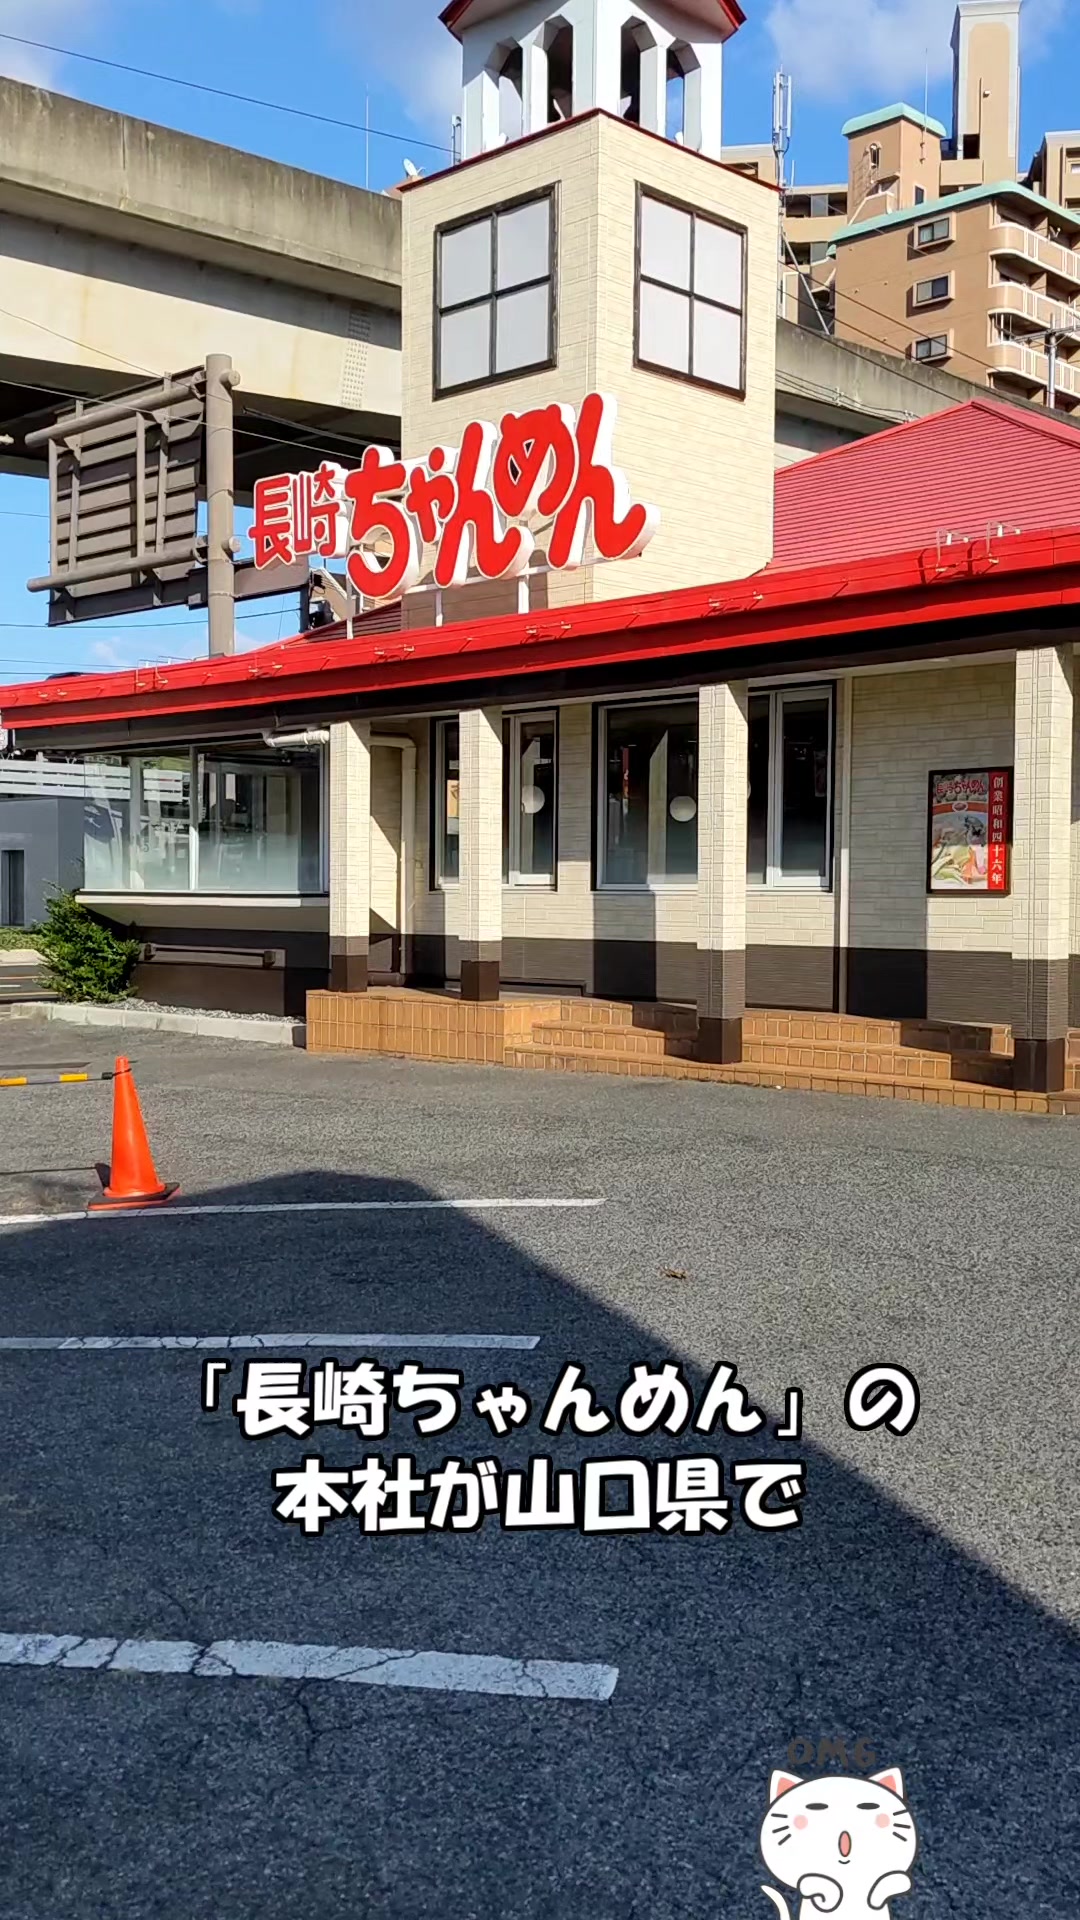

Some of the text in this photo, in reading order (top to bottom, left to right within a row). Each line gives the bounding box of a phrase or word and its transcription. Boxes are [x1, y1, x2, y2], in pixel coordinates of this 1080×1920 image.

[248, 393, 650, 599] 長崎ちゃんめん
[992, 776, 1004, 885] 創業昭和四十六年
